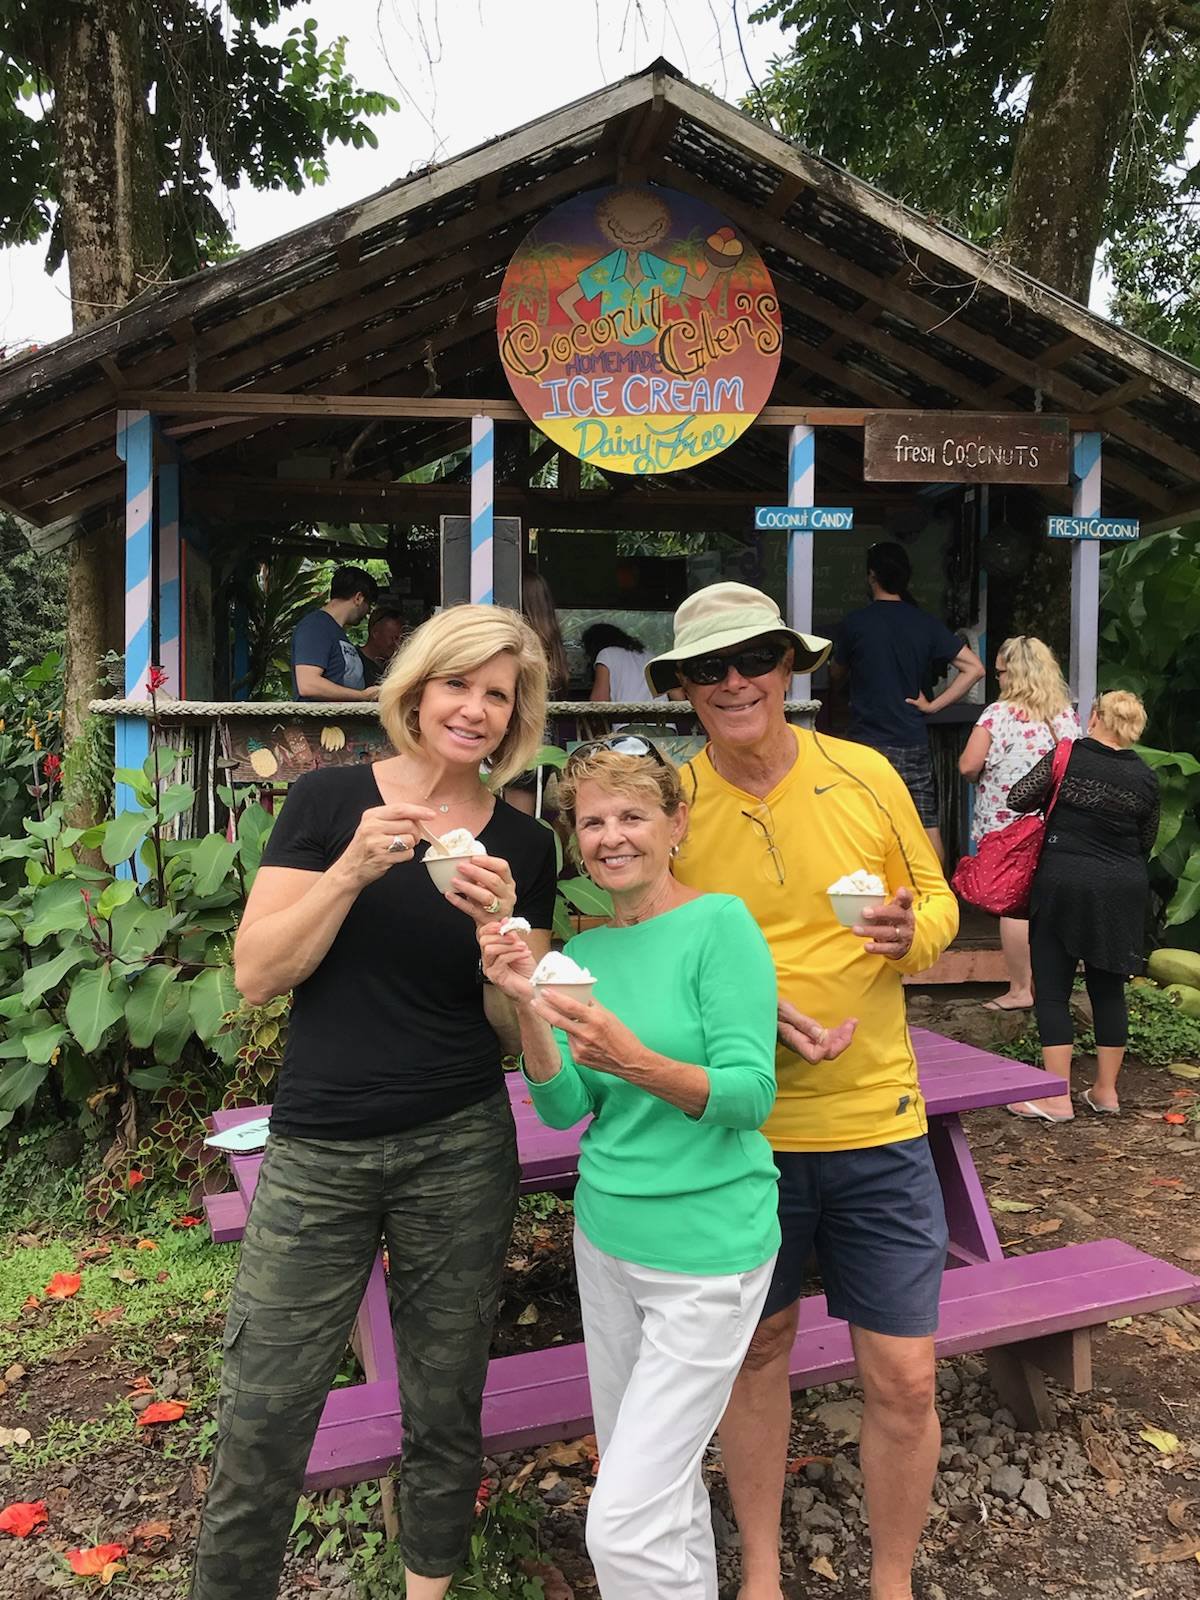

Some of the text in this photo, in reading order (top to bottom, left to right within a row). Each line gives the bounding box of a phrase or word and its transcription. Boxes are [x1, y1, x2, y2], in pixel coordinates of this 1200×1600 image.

[500, 286, 667, 382] Coconut
[565, 350, 663, 376] HOMEMADE
[539, 374, 744, 419] ICE CREAM
[572, 414, 737, 473] Dairy Free
[811, 509, 853, 529] CANDY
[1048, 518, 1088, 536] FRESH
